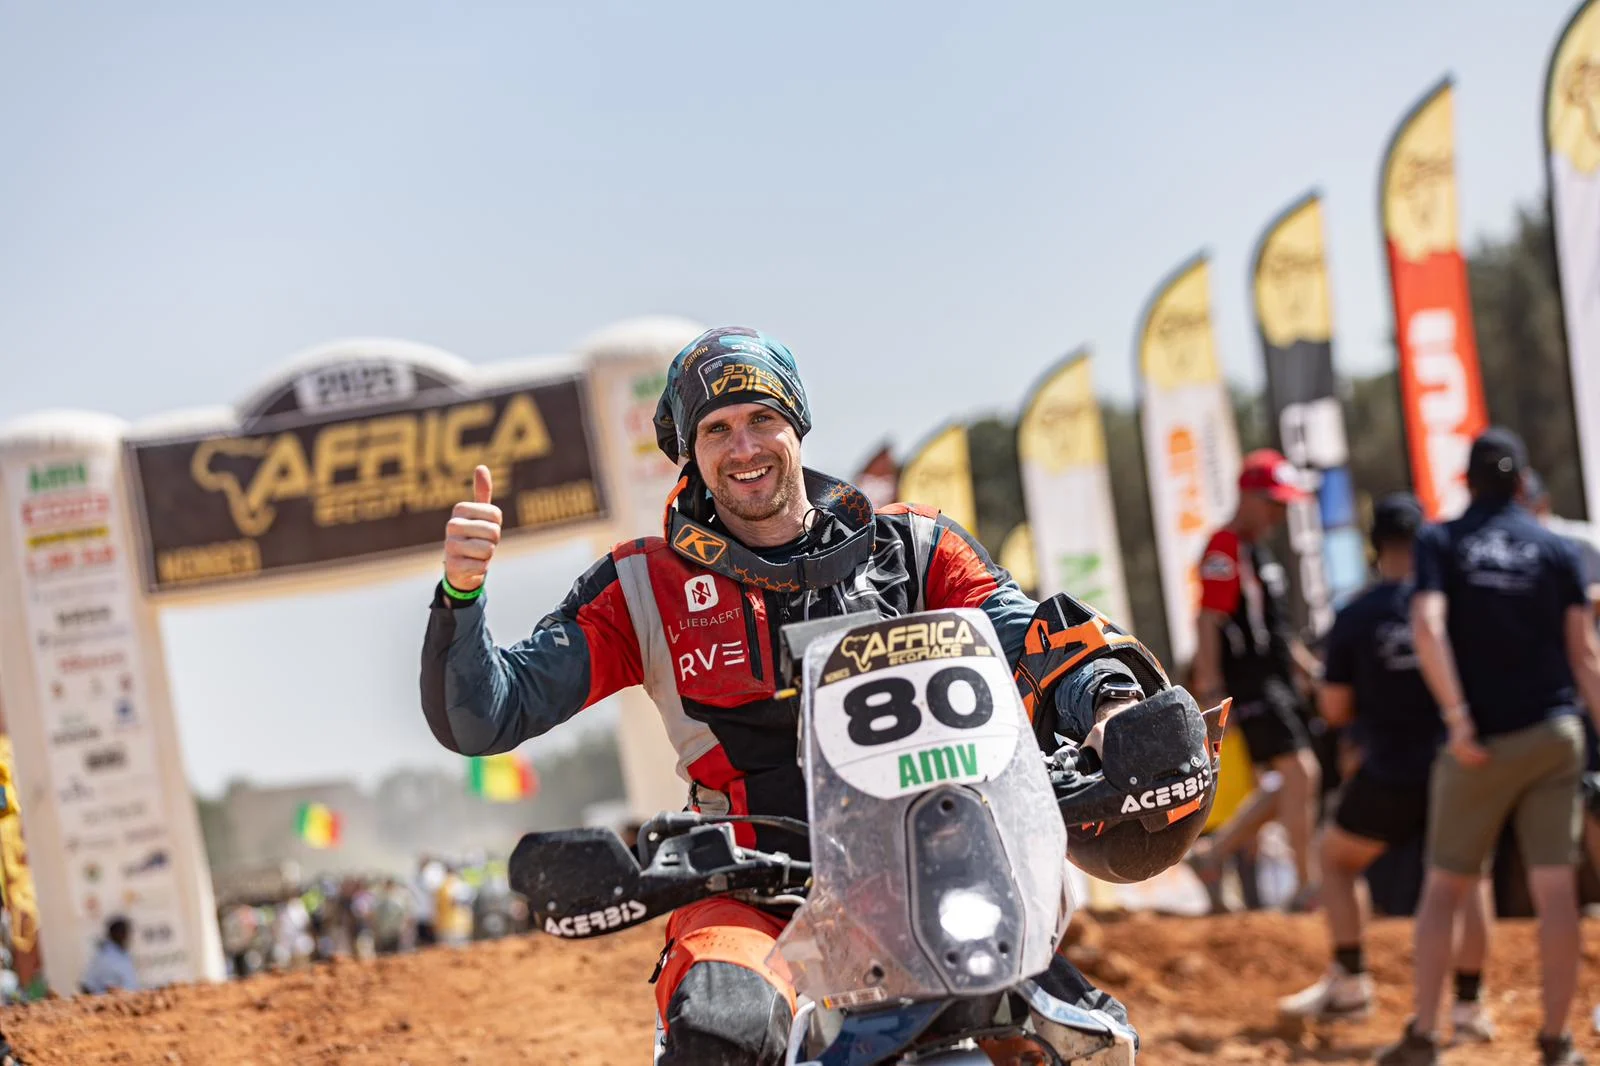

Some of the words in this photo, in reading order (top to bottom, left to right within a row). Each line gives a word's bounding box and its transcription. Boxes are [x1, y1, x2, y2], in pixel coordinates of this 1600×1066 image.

[247, 394, 552, 508] AFRICA
[680, 608, 741, 630] LIEBAERT
[861, 620, 974, 663] AFRICA
[889, 644, 963, 666] ECORACE
[843, 666, 994, 747] 80
[898, 743, 978, 788] AMV
